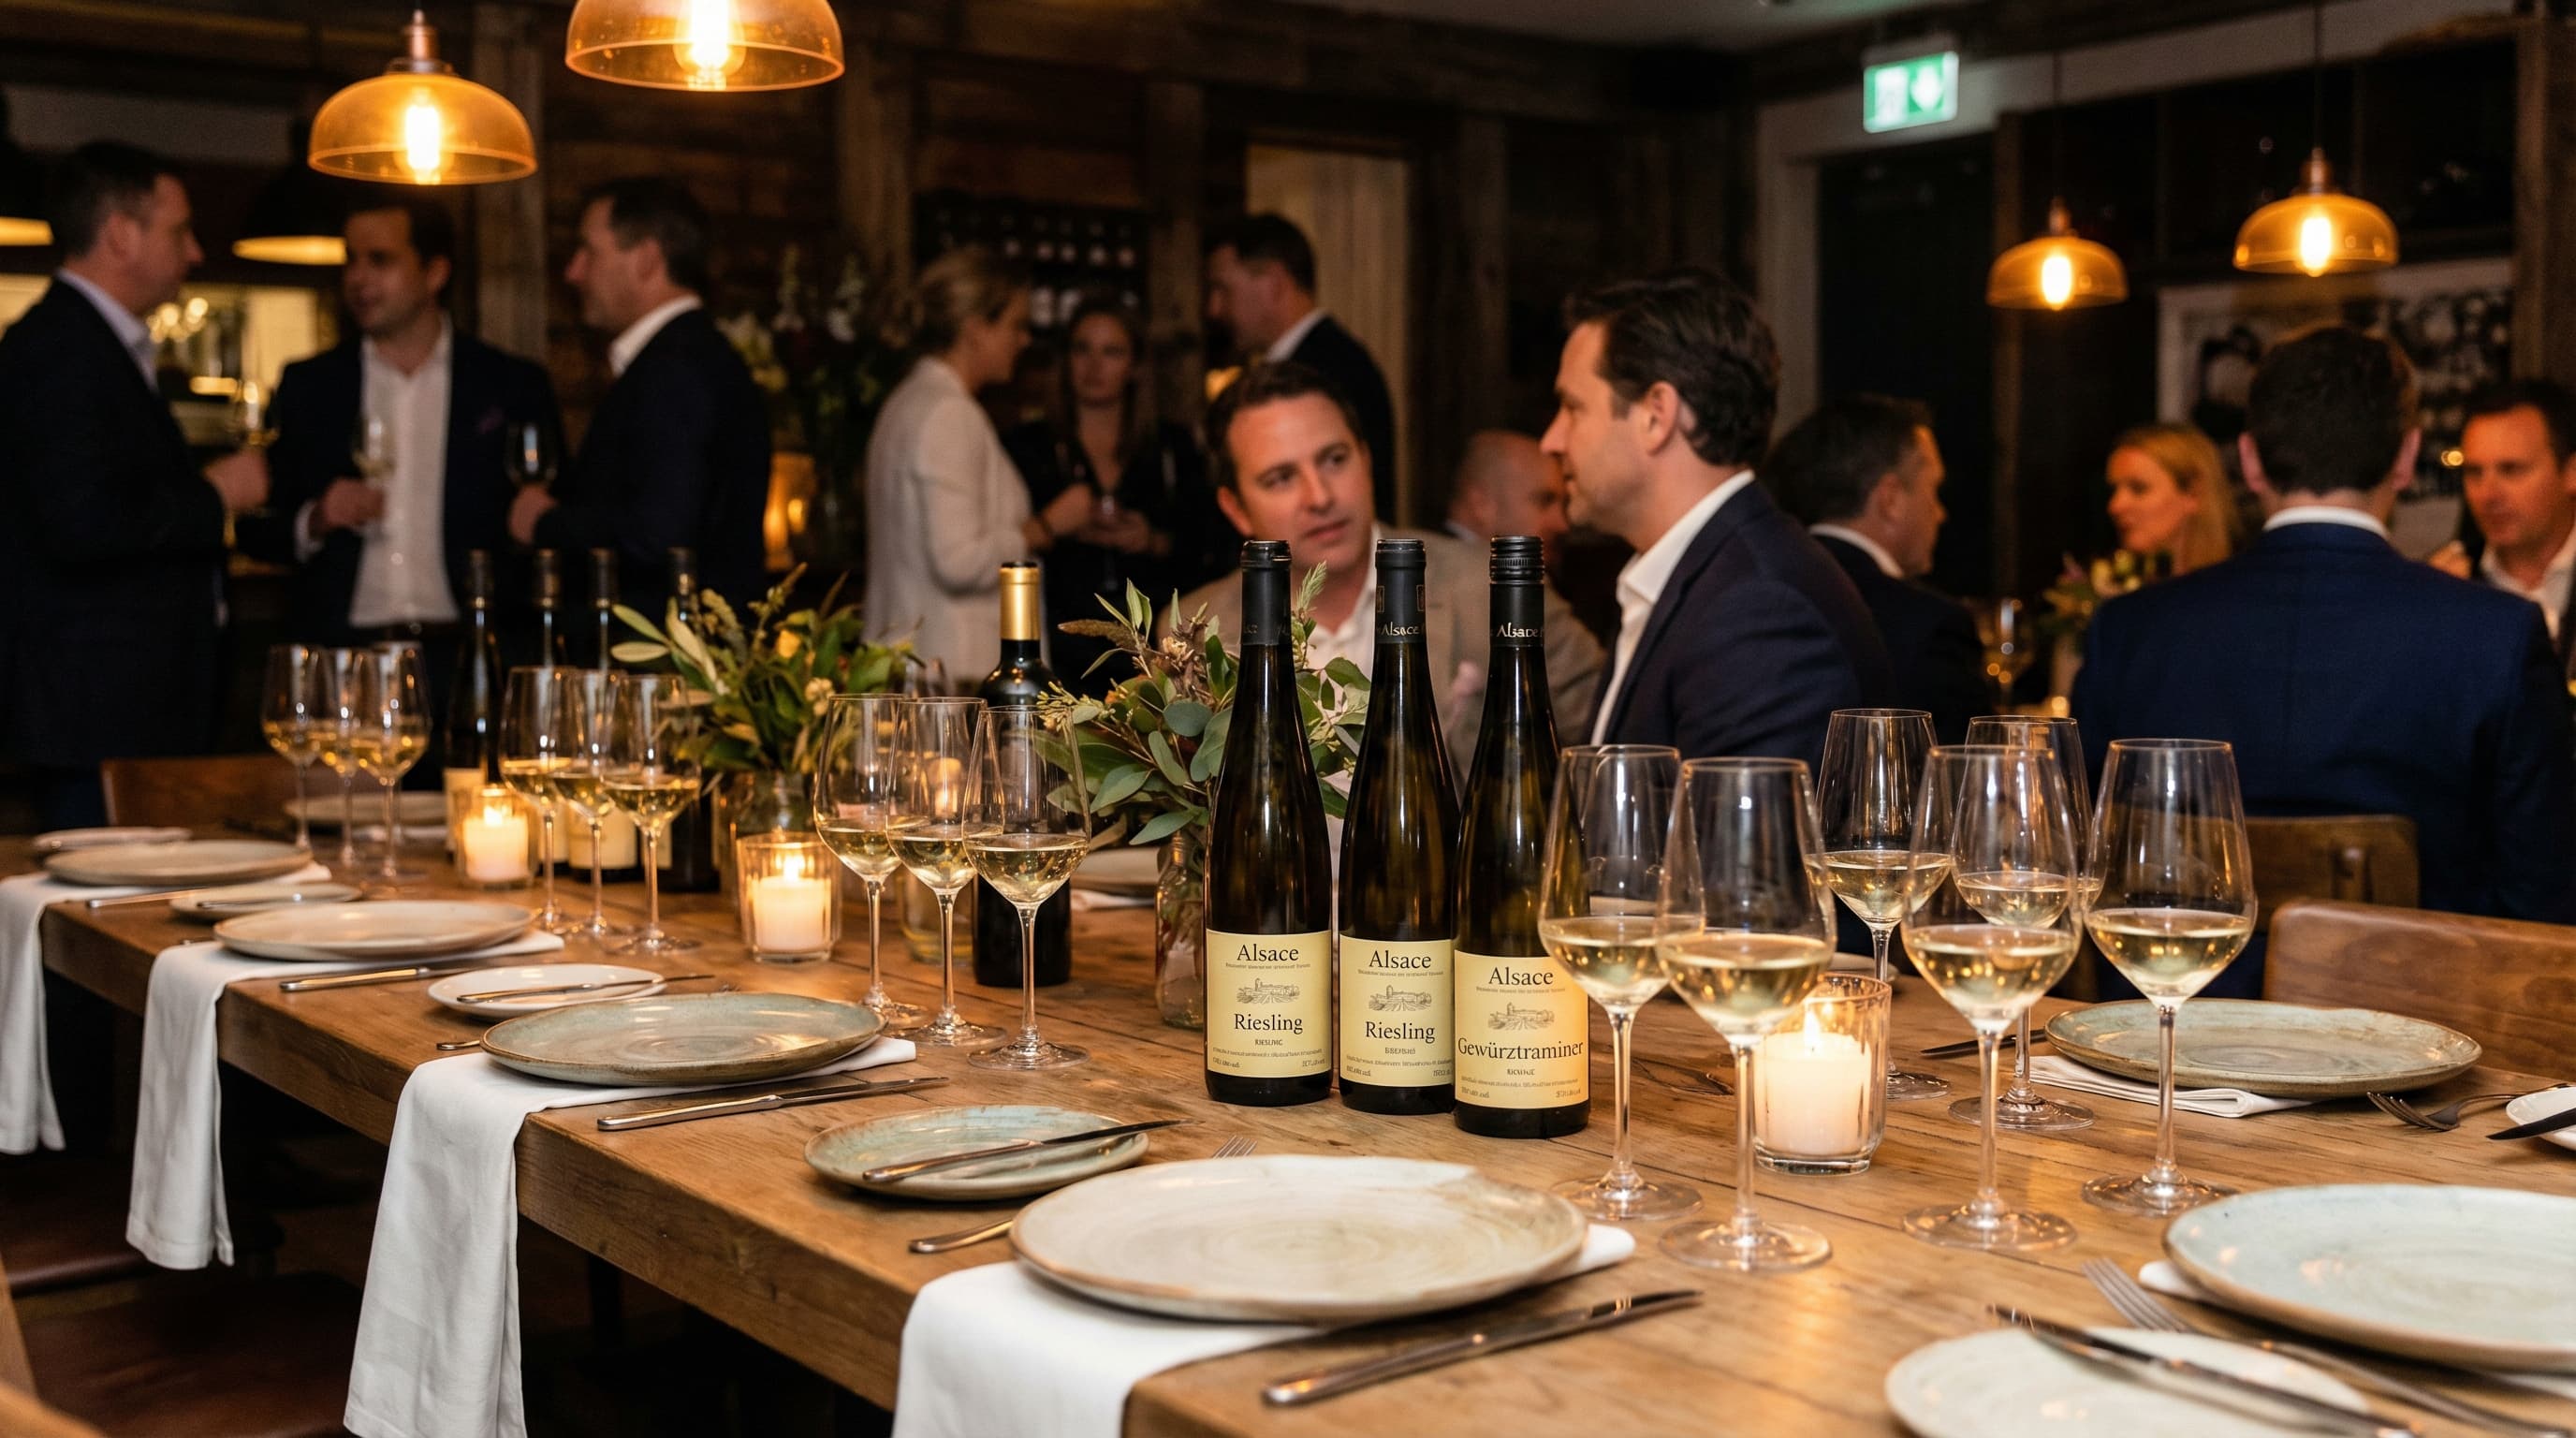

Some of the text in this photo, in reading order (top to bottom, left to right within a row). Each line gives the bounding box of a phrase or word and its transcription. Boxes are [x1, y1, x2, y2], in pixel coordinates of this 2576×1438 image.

[1237, 943, 1299, 961] Alsace
[1368, 949, 1432, 969] Alsace
[1488, 966, 1554, 986] Alsace
[1234, 1013, 1304, 1034] Riesling
[1365, 1020, 1436, 1044] Riesling
[1457, 1037, 1584, 1060] Gewürztraminer
